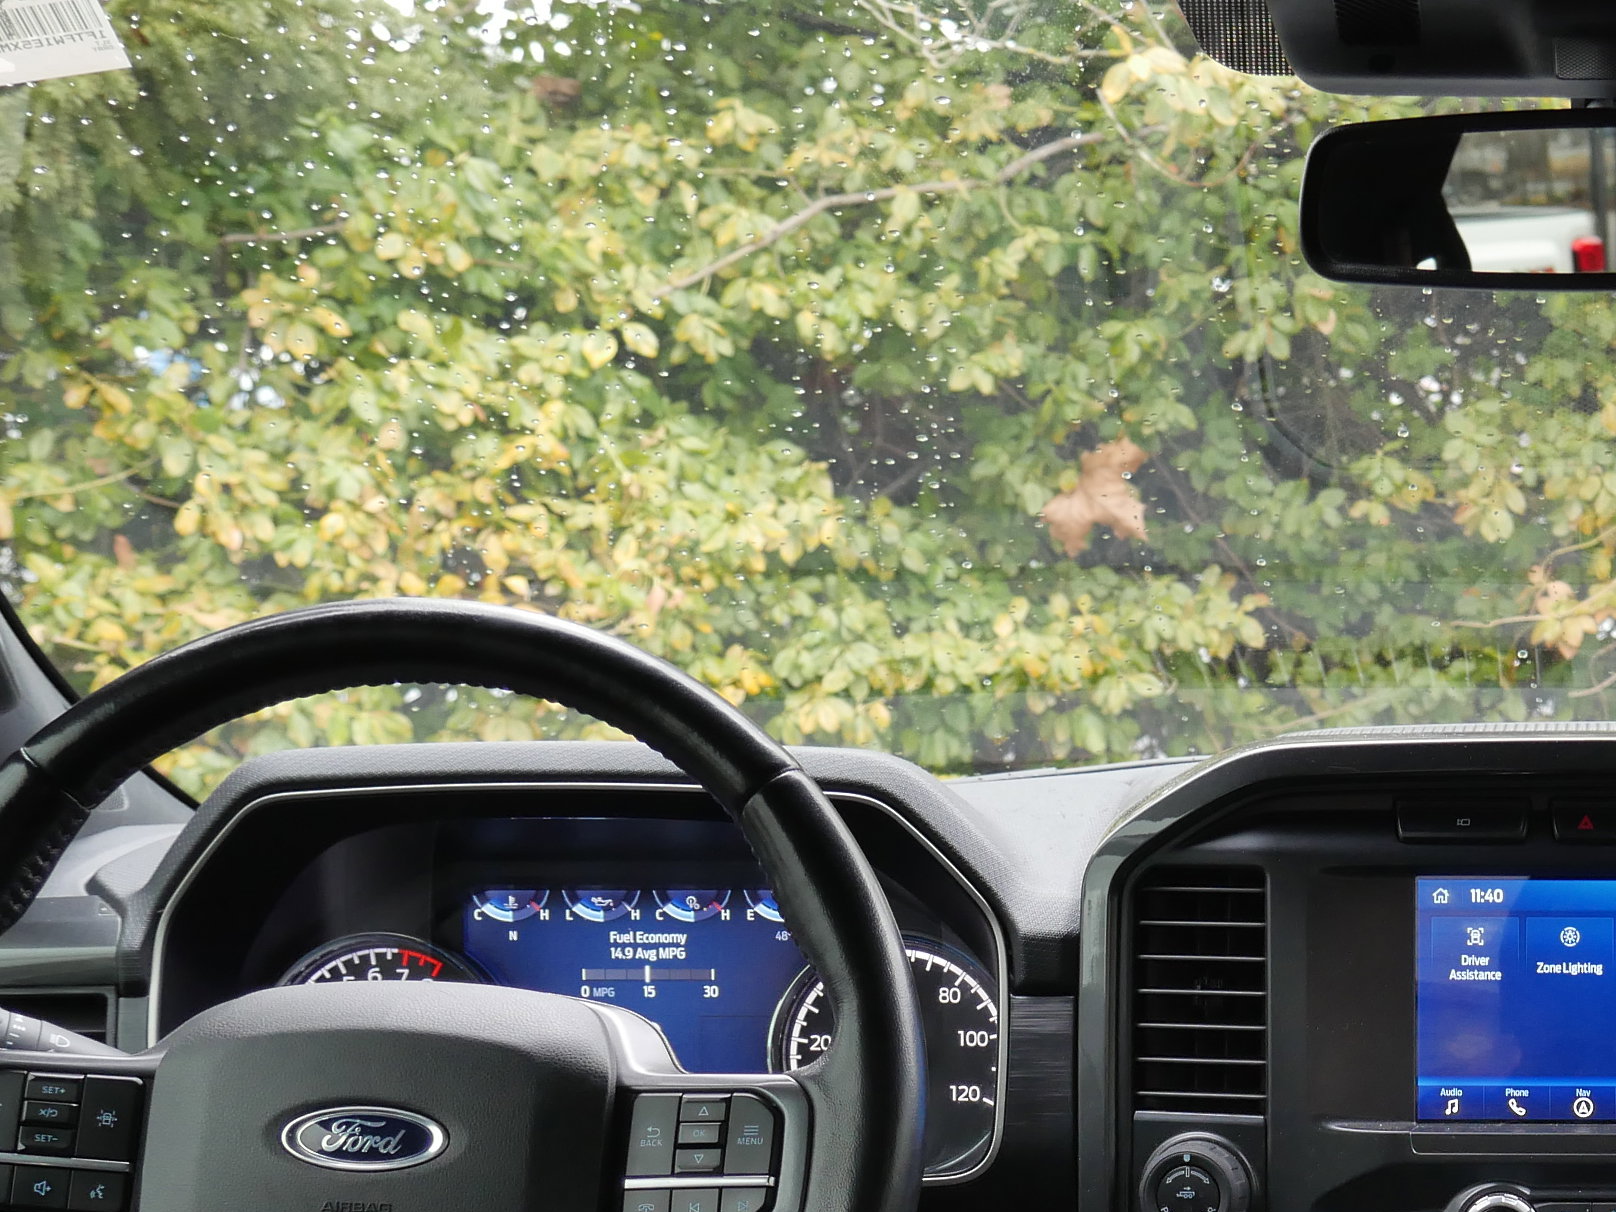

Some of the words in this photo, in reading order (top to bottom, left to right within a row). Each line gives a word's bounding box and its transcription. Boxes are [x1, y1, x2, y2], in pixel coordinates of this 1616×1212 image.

[1470, 888, 1503, 903] 11:40
[473, 909, 482, 921] C
[540, 909, 549, 921] H
[565, 909, 573, 921] L
[631, 909, 640, 921] H
[655, 909, 664, 921] C
[721, 909, 730, 921] H
[747, 909, 755, 921] E
[508, 931, 517, 941] N
[609, 931, 634, 943] Fuel
[636, 931, 687, 945] Economy
[610, 948, 633, 959] 14.9
[635, 948, 657, 961] Avg
[659, 948, 686, 959] MPG
[1461, 954, 1490, 967] Driver
[1449, 968, 1502, 981] Assistance
[1536, 962, 1561, 974] Zone
[1562, 962, 1603, 976] Lighting
[581, 986, 590, 998] 0
[593, 987, 615, 997] MPG
[643, 986, 656, 998] 15
[703, 986, 719, 998] 30
[938, 987, 961, 1003] 80
[809, 1034, 831, 1051] 20
[957, 1031, 989, 1047] 100
[949, 1085, 981, 1101] 120
[1440, 1087, 1463, 1097] Audio
[1505, 1088, 1529, 1097] Phone
[1575, 1088, 1591, 1097] Nav
[321, 1118, 406, 1155] Ford
[692, 1129, 706, 1137] OK
[640, 1138, 663, 1147] BACK
[737, 1137, 763, 1145] MENU
